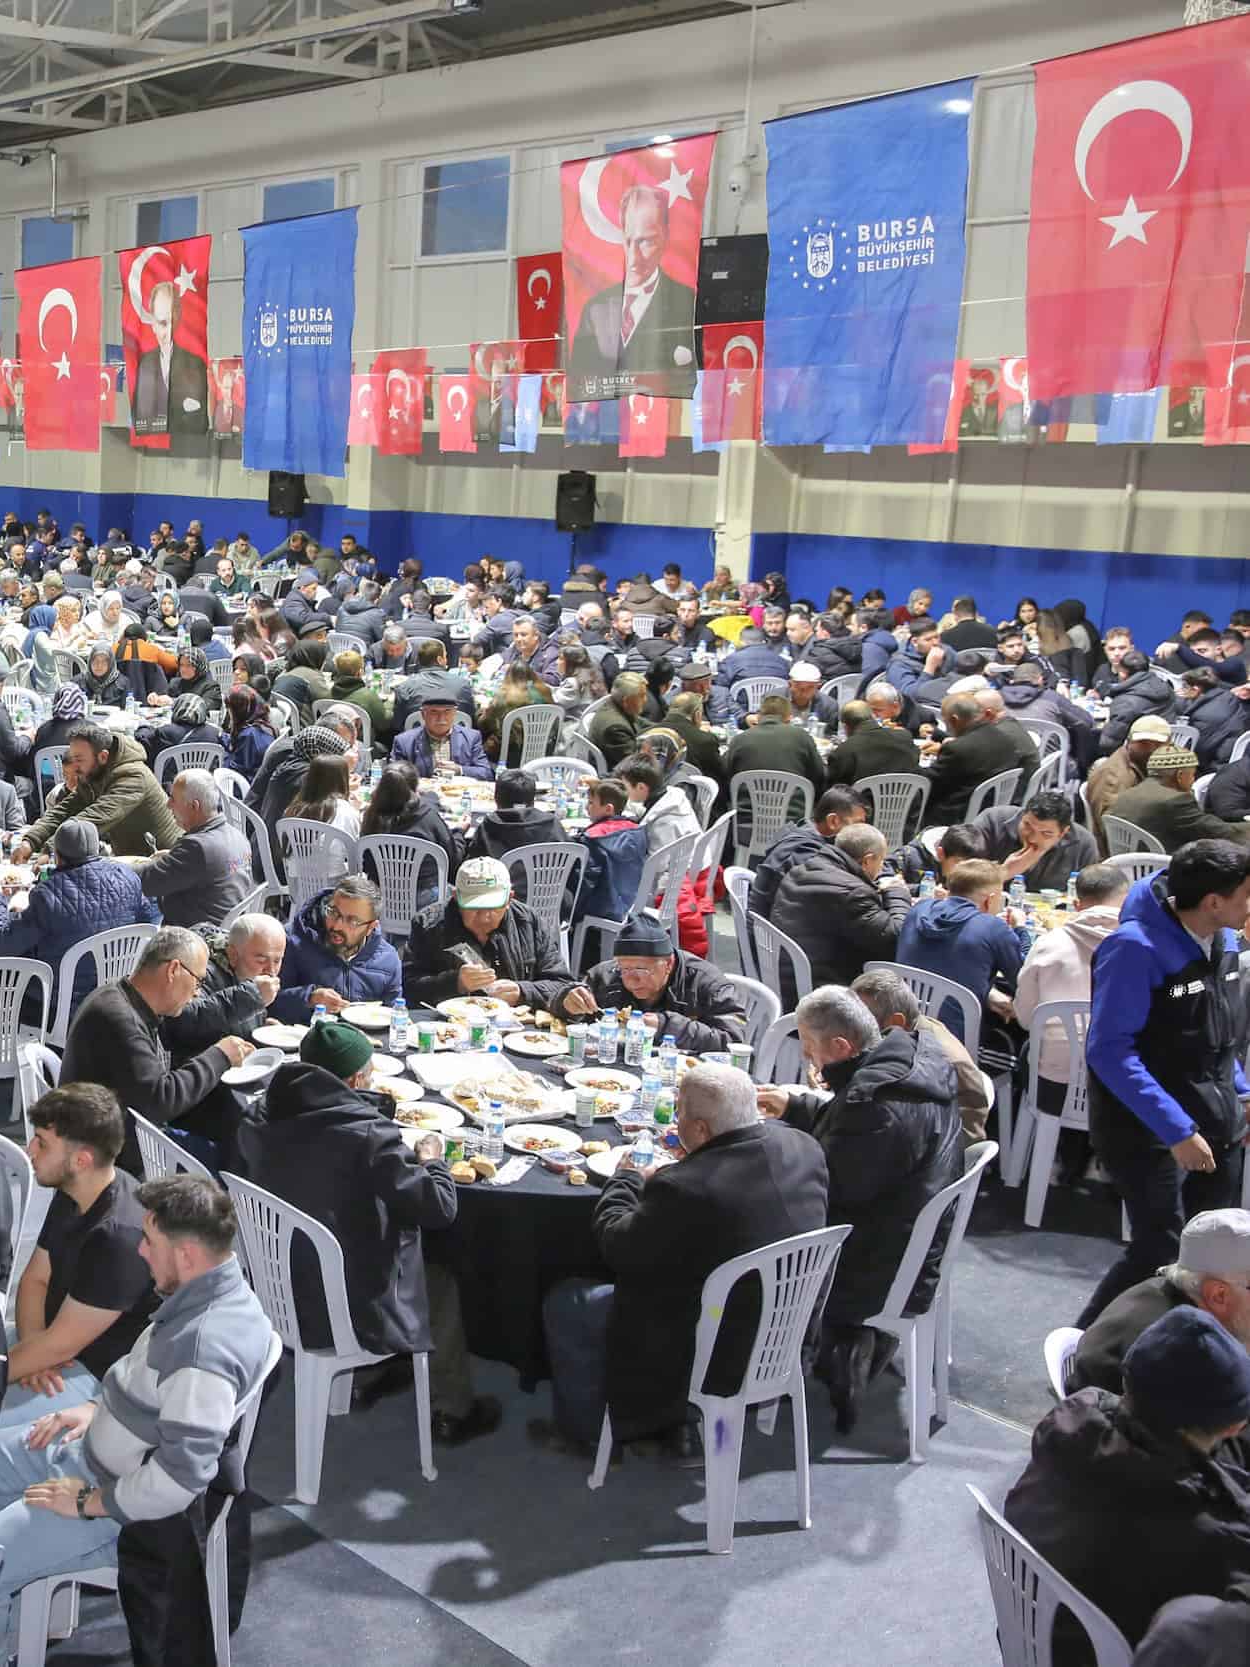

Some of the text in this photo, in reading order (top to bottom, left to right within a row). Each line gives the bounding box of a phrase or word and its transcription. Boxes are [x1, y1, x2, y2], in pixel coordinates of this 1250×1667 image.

[858, 216, 935, 242] BURSA
[857, 237, 935, 257] BÜYÜKŞEHİR
[857, 250, 934, 272] BELEDİYESİ
[289, 307, 333, 322] BURSA
